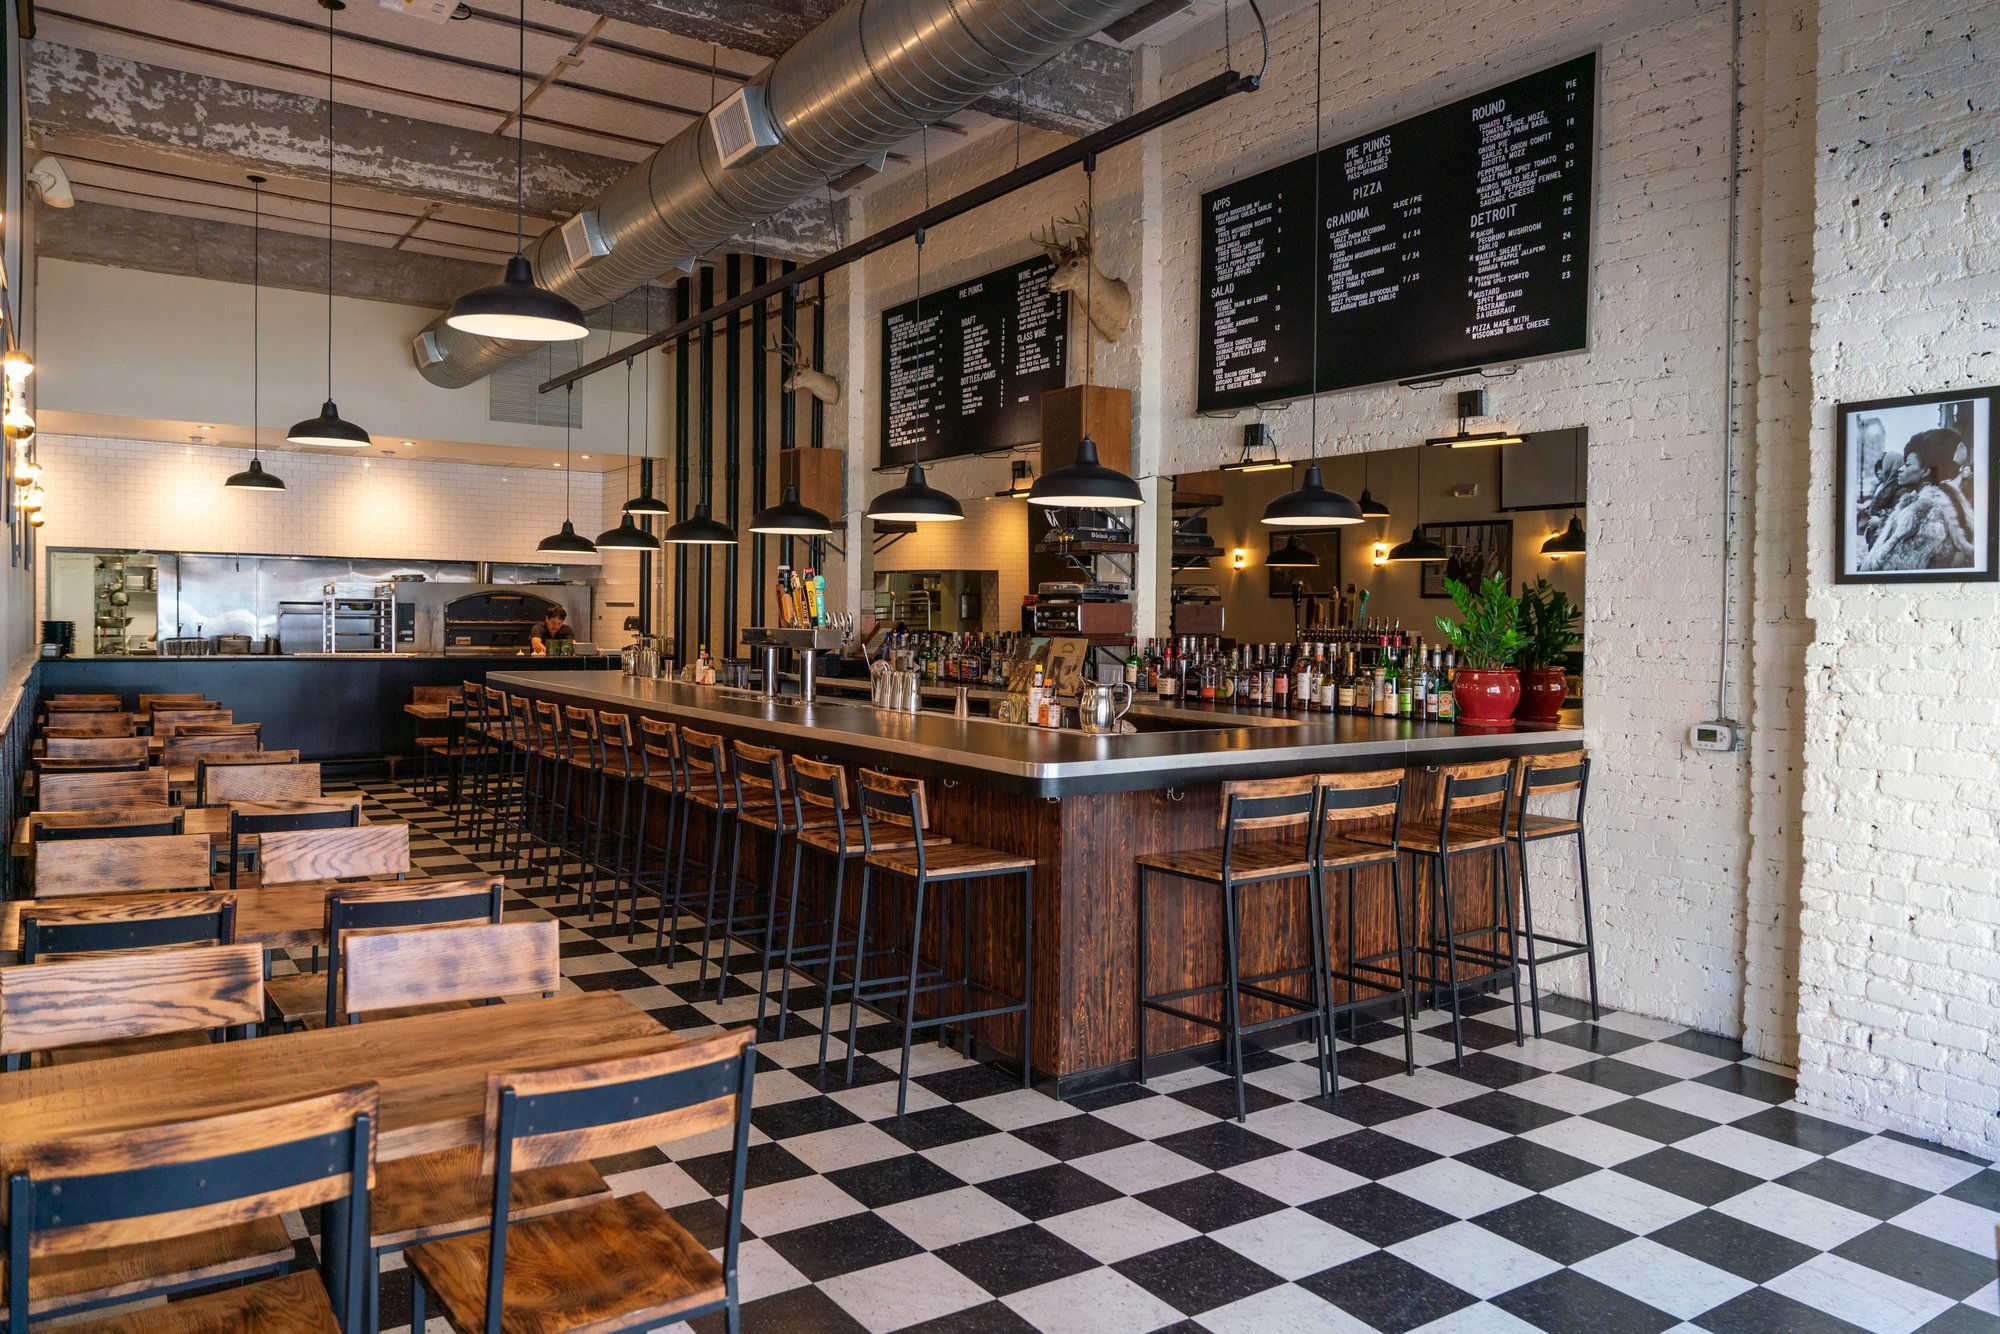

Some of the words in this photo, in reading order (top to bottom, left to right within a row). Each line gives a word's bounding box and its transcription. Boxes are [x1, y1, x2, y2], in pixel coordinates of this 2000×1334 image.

[1566, 79, 1577, 89] PIE
[1568, 93, 1575, 101] 17
[1472, 99, 1505, 121] ROUND
[1479, 119, 1500, 131] TOMATO
[1503, 114, 1512, 123] PIE
[1482, 125, 1503, 137] TOMATO
[1506, 118, 1524, 129] SAUCE
[1528, 111, 1544, 122] MOZZ
[1567, 118, 1574, 126] 18
[1482, 130, 1511, 144] PECORINO
[1514, 124, 1529, 134] PARM
[1531, 118, 1549, 128] BASIL
[1346, 145, 1359, 160] PIE
[1363, 135, 1391, 154] PUNKS
[1478, 143, 1495, 154] ONION
[1498, 139, 1508, 148] PIE
[1482, 148, 1502, 160] GARLIC
[1510, 140, 1527, 151] ONION
[1530, 132, 1552, 145] CONFIT
[1481, 155, 1506, 168] RICOTTA
[1509, 149, 1525, 159] MOZZ
[1477, 163, 1508, 178] PEPPERONI
[1481, 174, 1495, 184] MOZZ
[1497, 169, 1512, 179] PARM
[1515, 163, 1531, 173] SPICY
[1534, 156, 1556, 168] TOMATO
[1477, 182, 1499, 194] MAUROS
[1501, 176, 1520, 187] MOLTO
[1522, 170, 1538, 180] MEAT
[1480, 188, 1501, 200] SALAMI
[1504, 178, 1536, 193] PEPPERONI
[1538, 171, 1562, 183] FENNEL
[1353, 181, 1382, 200] PIZZA
[1480, 194, 1506, 207] SAUSAGE
[1509, 186, 1534, 199] CHEESE
[1563, 193, 1573, 202] PIE
[1212, 197, 1230, 212] APPS
[1564, 207, 1572, 215] 22
[1326, 207, 1369, 229] GRANDMA
[1471, 204, 1517, 227] DETROIT
[1330, 228, 1349, 239] CLASSIC
[1334, 236, 1346, 244] MOZZ
[1348, 231, 1361, 240] PARM
[1363, 224, 1385, 236] PECORINO
[1476, 228, 1493, 238] BACON
[1478, 232, 1505, 245] PECORINO
[1508, 223, 1541, 237] MUSHROOM
[1334, 240, 1352, 250] TOMATO
[1354, 235, 1370, 245] SAUCE
[1333, 254, 1353, 265] SPINACH
[1355, 247, 1380, 259] MUSHROOM
[1382, 243, 1396, 252] MOZZ
[1475, 251, 1496, 261] WAIKIKI
[1499, 244, 1522, 255] SNEAKY
[1493, 252, 1518, 262] PINEAPPLE
[1521, 246, 1545, 256] JALAPENO
[1333, 262, 1349, 271] CREAM
[1478, 264, 1498, 273] BANANA
[1328, 269, 1352, 281] PEPPERONI
[1332, 278, 1344, 286] MOZZ
[1346, 274, 1358, 282] PARM
[1361, 268, 1384, 278] PECORINO
[1508, 272, 1529, 282] TOMATO
[959, 289, 967, 298] PIE
[968, 284, 983, 295] PUNKS
[1211, 283, 1234, 298] SALAD
[1346, 279, 1364, 289] TOMATO
[1474, 288, 1500, 299] MUSTARD
[1496, 290, 1522, 301] MUSTARD
[1477, 301, 1505, 312] PASTRAMI
[961, 315, 976, 327] DRAFT
[1472, 323, 1490, 332] PIZZA
[1493, 319, 1510, 328] MADE
[1513, 316, 1529, 324] WITH
[1017, 332, 1033, 343] GLASS
[1034, 328, 1046, 338] WINE
[1472, 328, 1503, 339] WISCONSIN
[1506, 324, 1524, 333] BRICK
[1526, 319, 1550, 329] CHEESE
